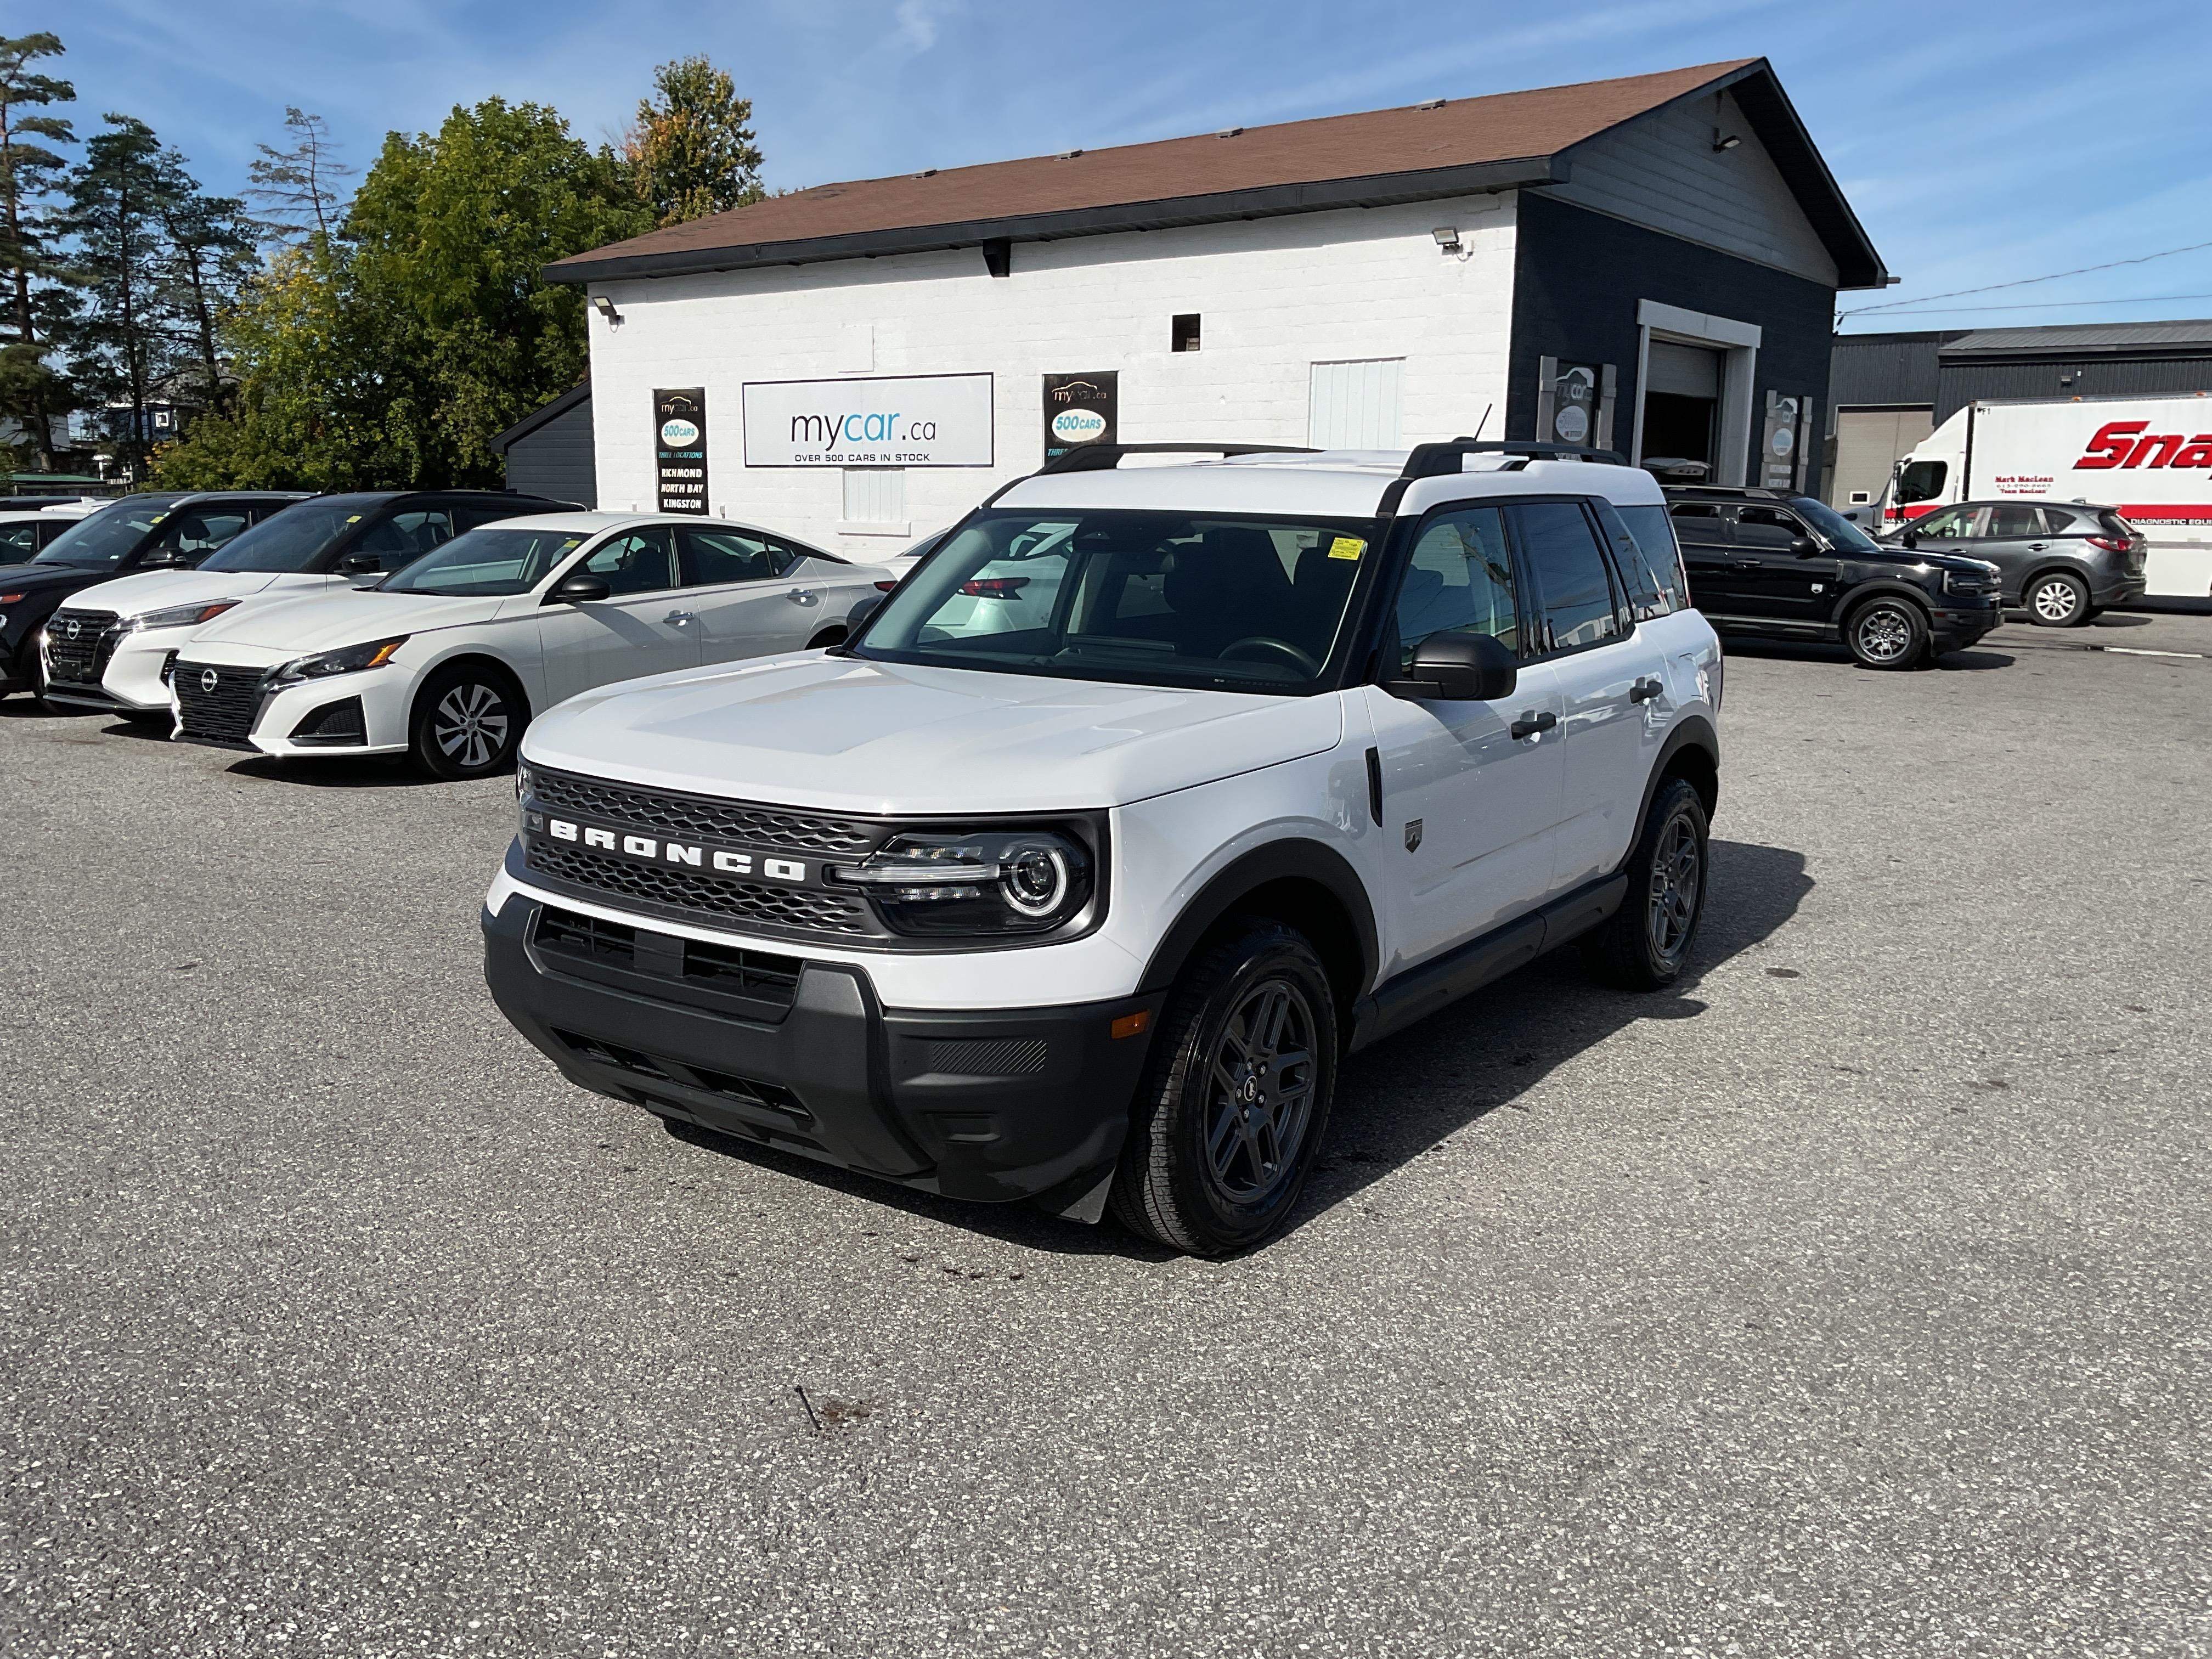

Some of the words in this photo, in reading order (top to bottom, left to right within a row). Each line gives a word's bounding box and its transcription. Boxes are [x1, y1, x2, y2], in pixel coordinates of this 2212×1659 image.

[791, 413, 936, 452] mycar.ca
[2072, 420, 2212, 481] Sna
[895, 453, 930, 461] STOCK
[662, 469, 702, 478] RICHMOND
[661, 484, 685, 493] NORTH
[687, 484, 704, 493] BAY
[663, 499, 702, 509] KINGSTON
[550, 819, 806, 882] BRONCO
